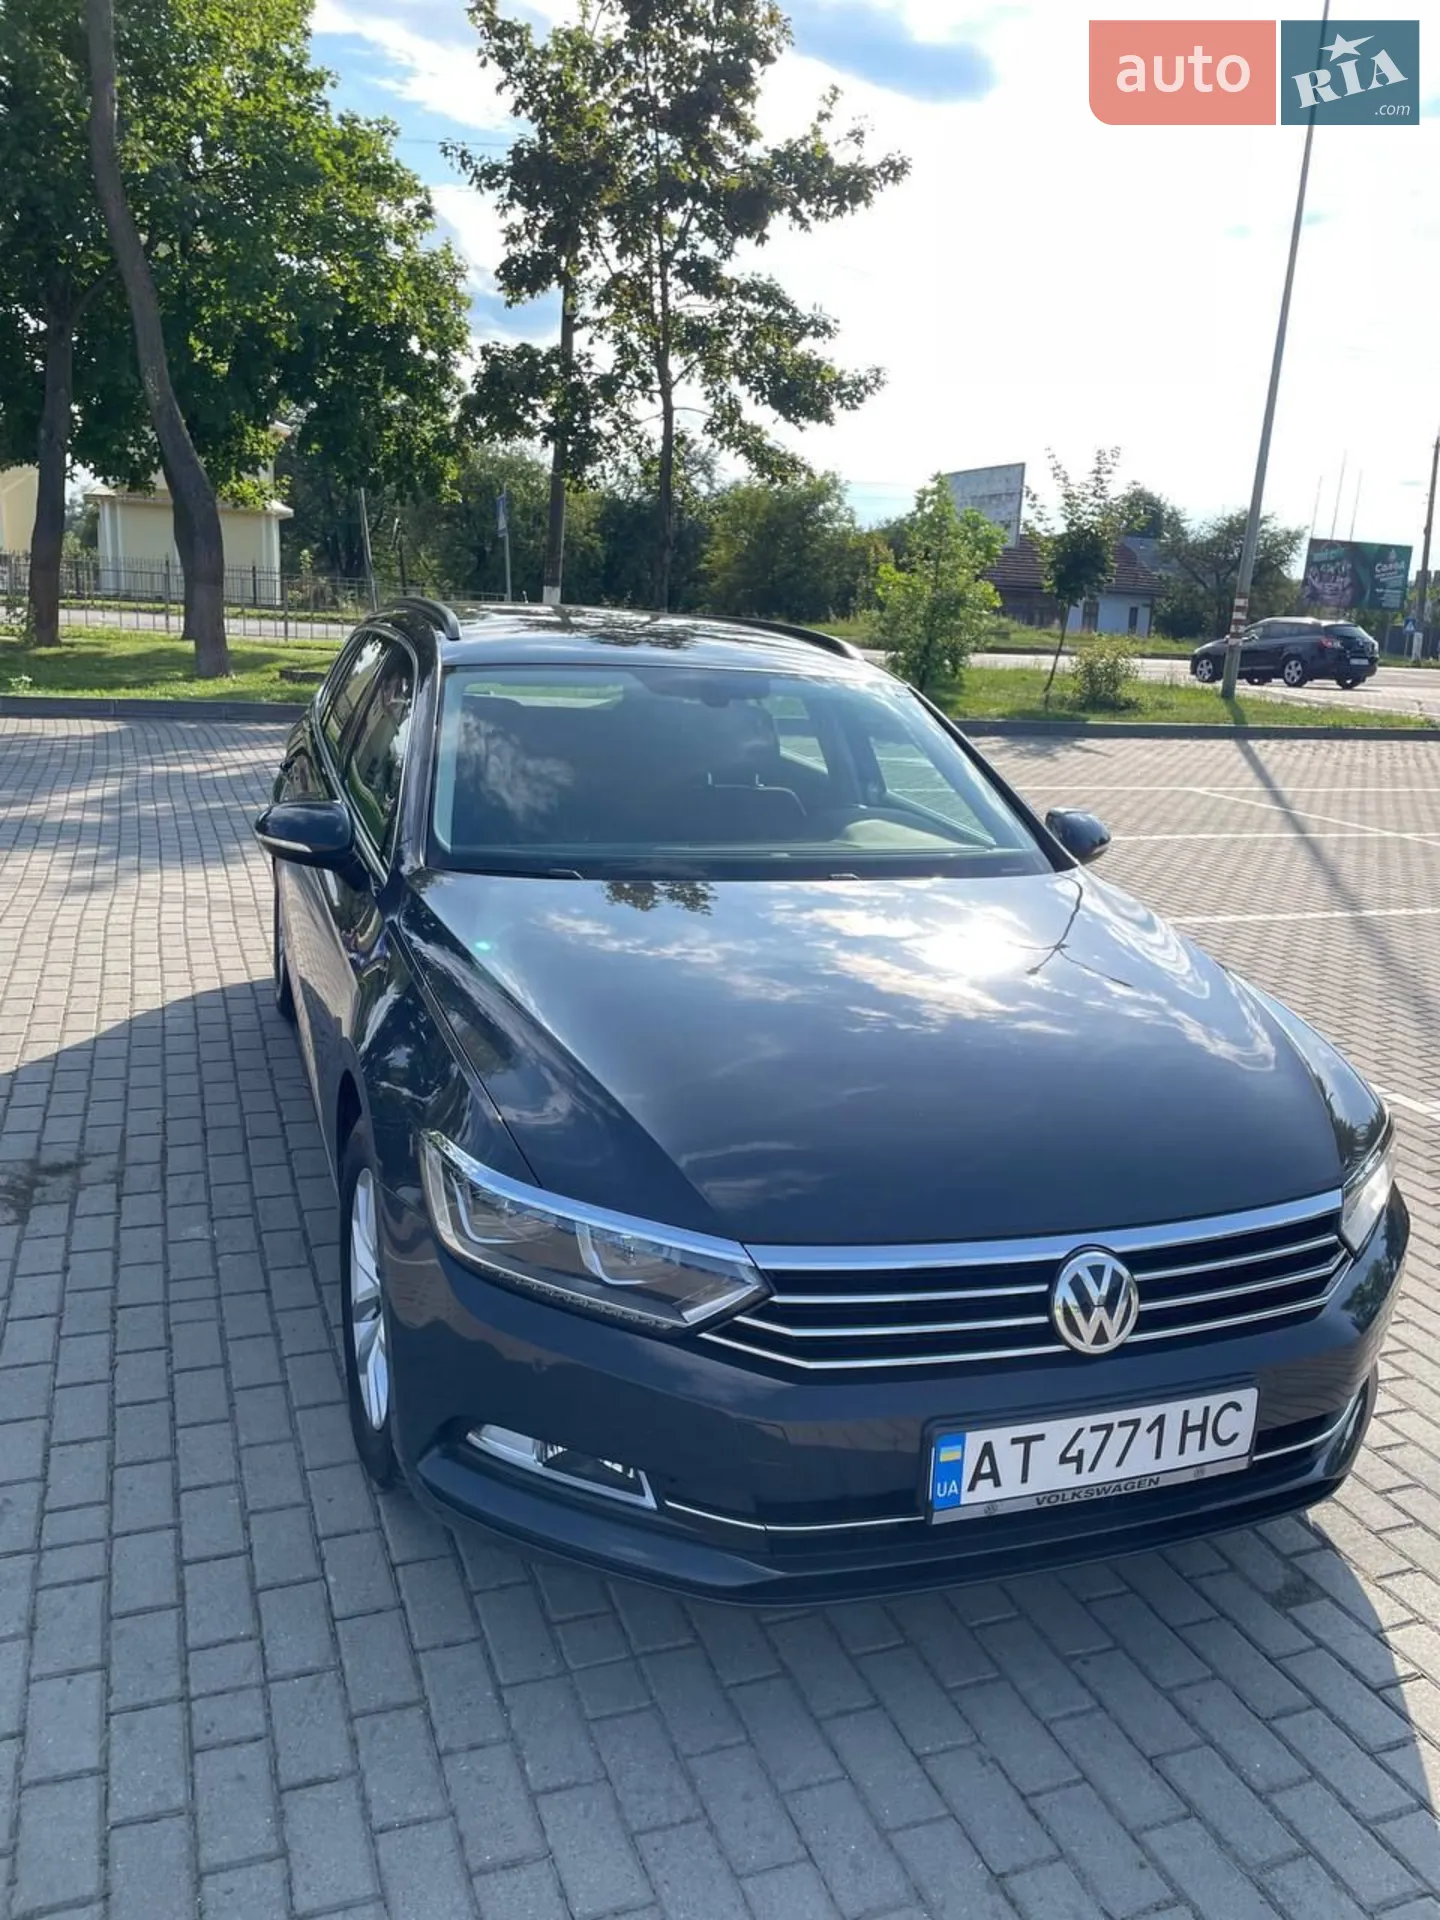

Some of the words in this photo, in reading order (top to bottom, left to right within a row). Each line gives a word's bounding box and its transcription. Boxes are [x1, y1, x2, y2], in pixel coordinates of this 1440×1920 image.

[967, 1433, 1045, 1492] AT
[1058, 1413, 1166, 1475] 4771
[1178, 1401, 1242, 1457] HC
[936, 1480, 958, 1498] UA
[1035, 1476, 1160, 1506] VOLKSWAGEN
